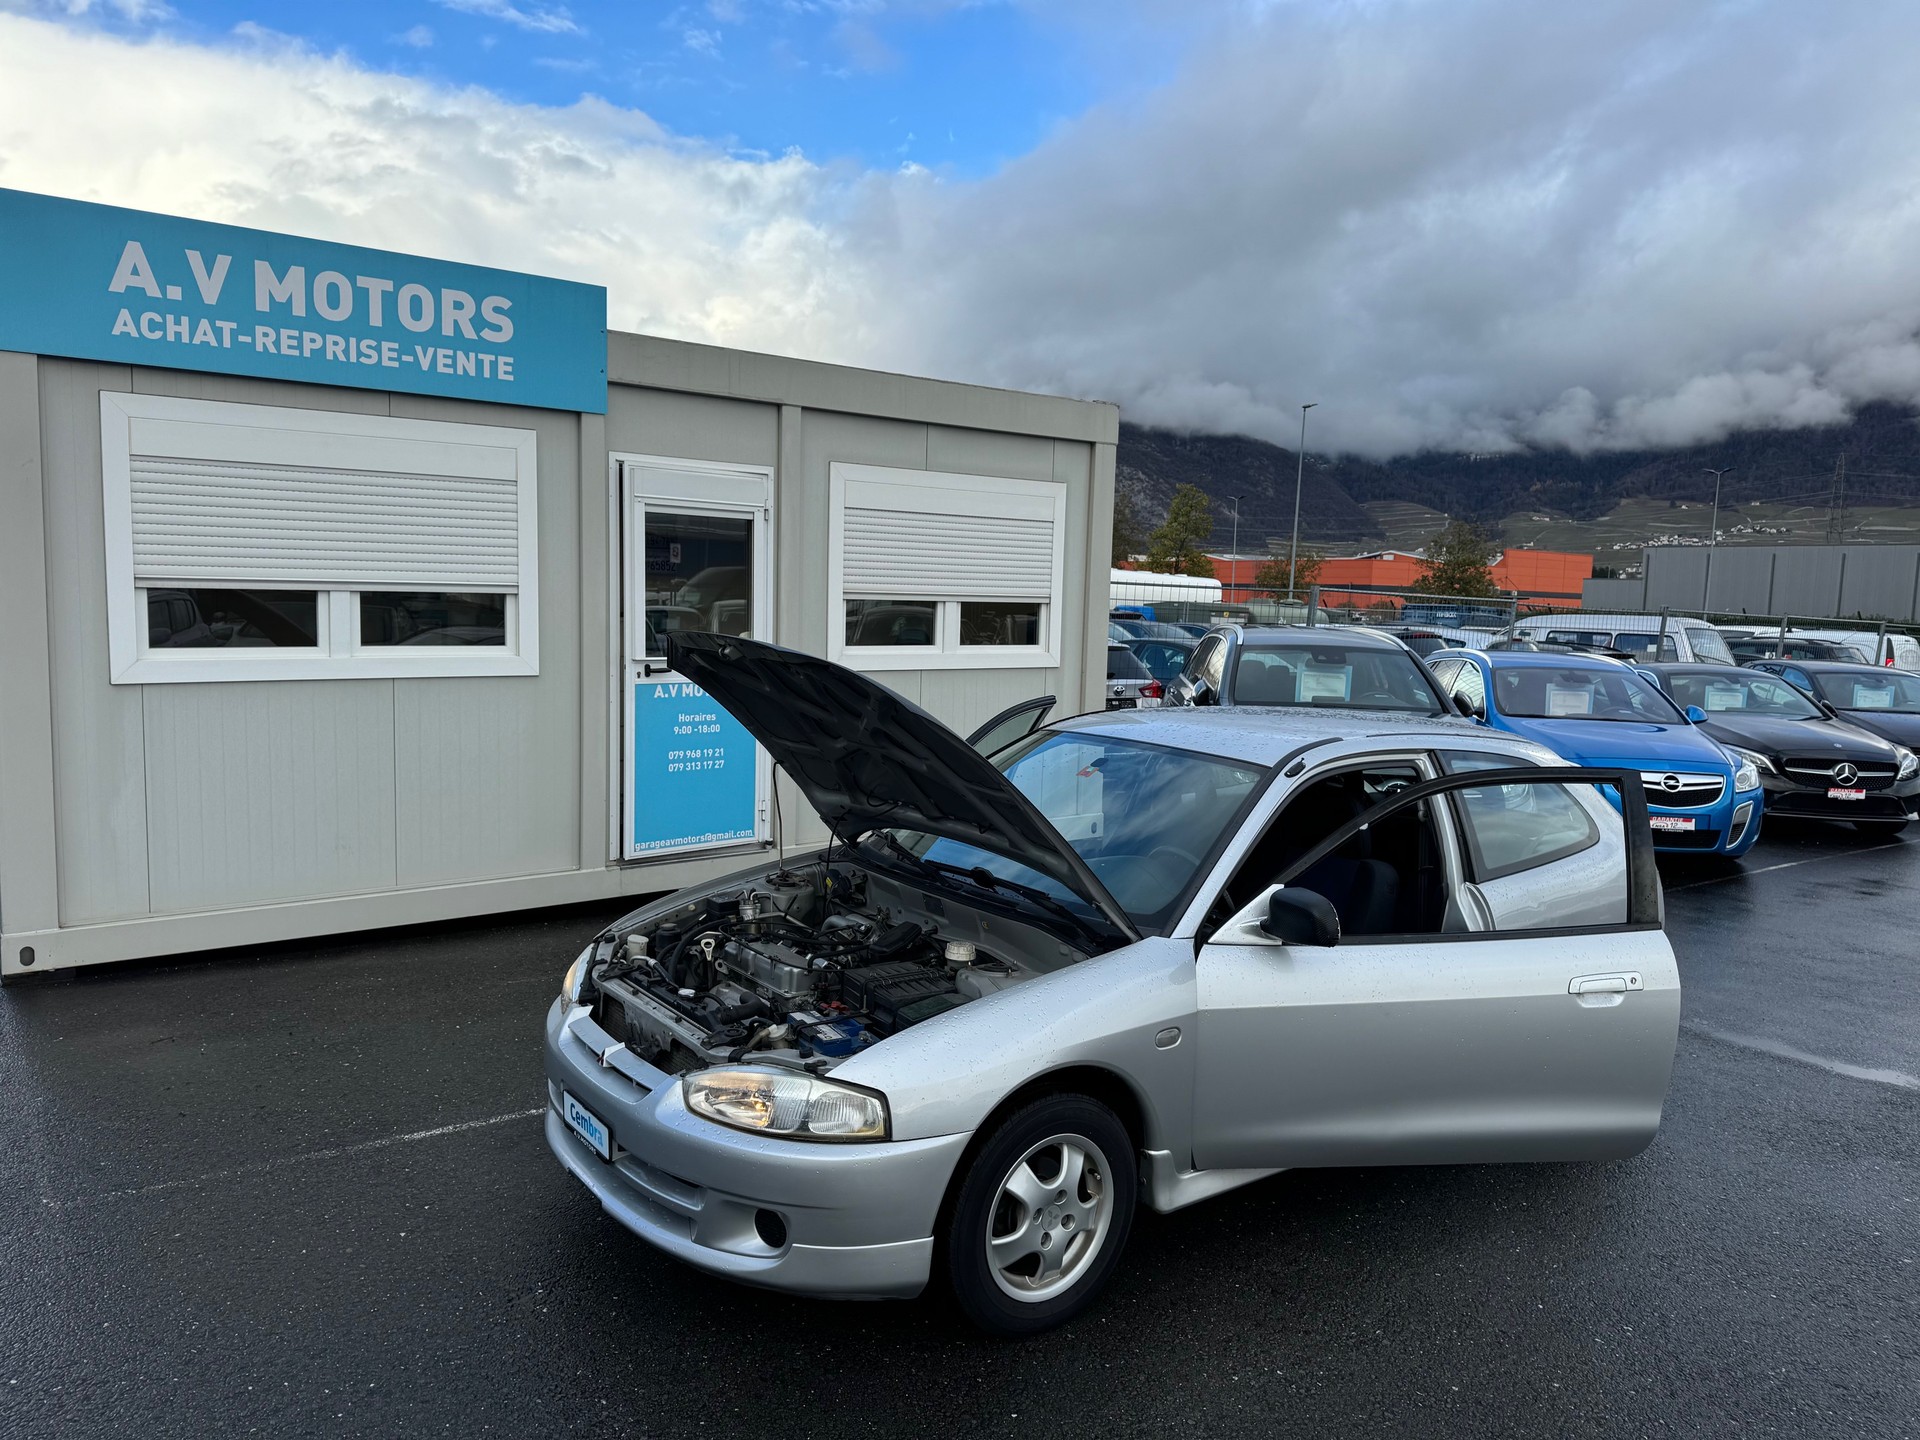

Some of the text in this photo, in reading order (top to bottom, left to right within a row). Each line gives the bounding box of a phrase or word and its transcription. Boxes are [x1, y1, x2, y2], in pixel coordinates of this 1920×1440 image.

[108, 240, 514, 343] A.V MOTORS
[111, 308, 514, 381] ACHAT-REPRISE-VENTE
[654, 684, 678, 698] A.V
[678, 712, 716, 722] Horaires
[673, 725, 692, 735] 9:00
[668, 747, 724, 760] 079 968 19 21
[668, 759, 725, 772] 079 313 17 27
[635, 829, 753, 851] garageavmotors@gmail.com
[570, 1102, 603, 1147] Cembra
